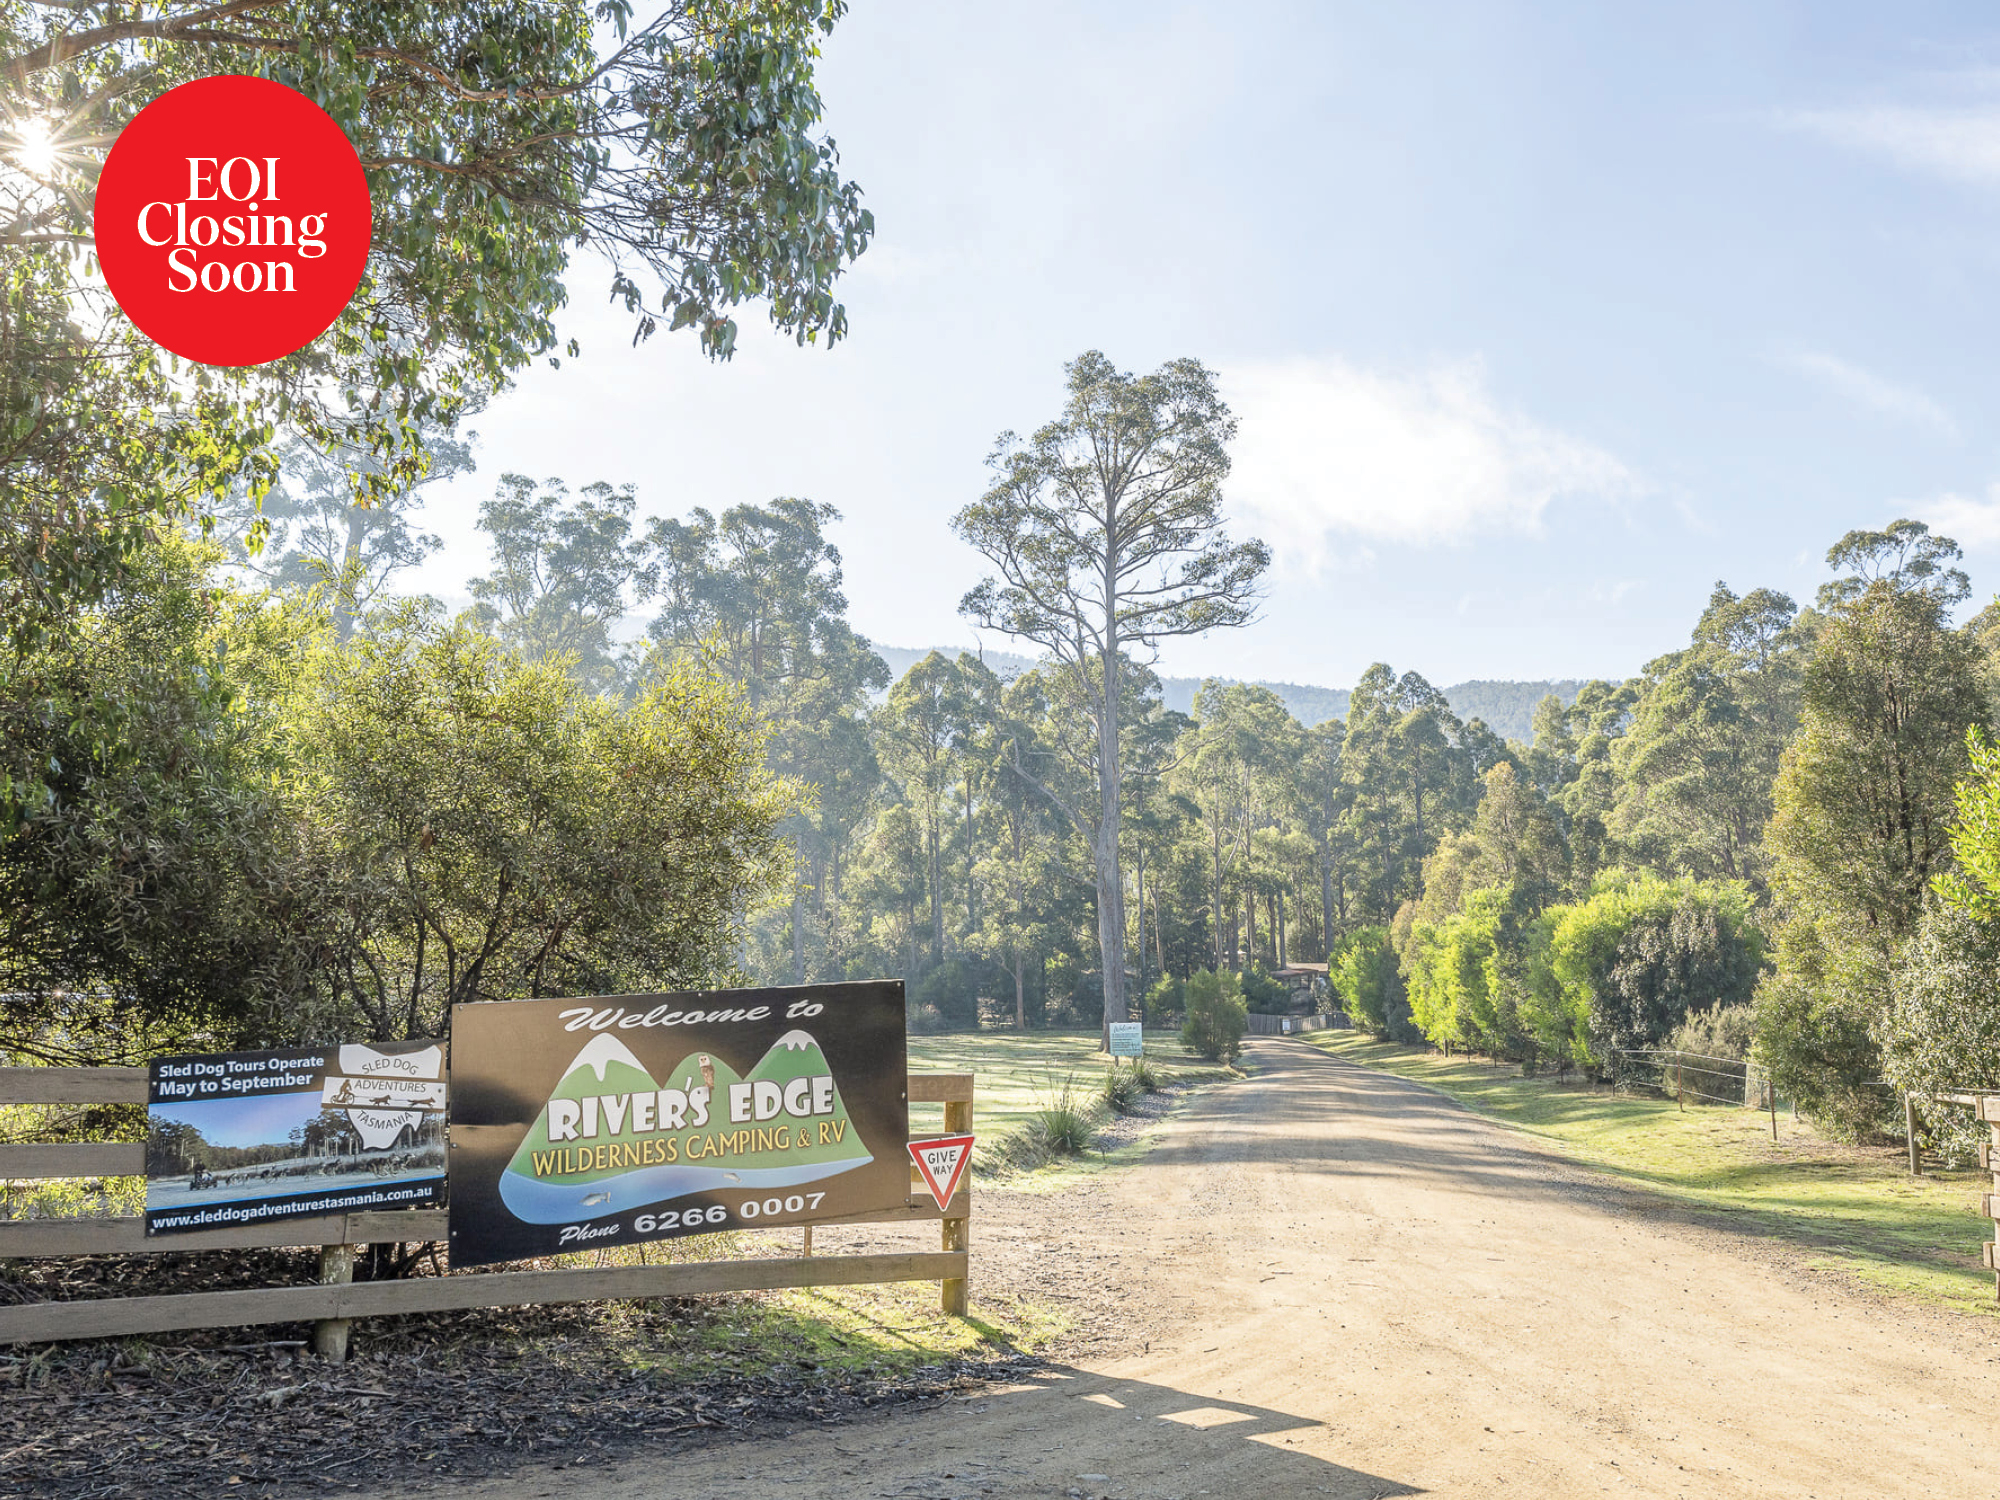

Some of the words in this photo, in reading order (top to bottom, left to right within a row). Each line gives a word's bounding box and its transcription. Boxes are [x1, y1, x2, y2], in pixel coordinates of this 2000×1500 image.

[558, 1004, 771, 1032] Welcome
[785, 999, 824, 1018] to
[159, 1064, 192, 1078] Sled
[194, 1063, 225, 1077] Dog
[227, 1060, 265, 1073] Tours
[268, 1056, 324, 1071] Operate
[362, 1059, 390, 1074] SLED
[393, 1058, 418, 1075] DOG
[159, 1080, 197, 1096] May
[200, 1078, 218, 1093] to
[221, 1072, 313, 1092] September
[354, 1079, 426, 1092] ADVENTURES
[356, 1109, 413, 1130] TASMANIA
[547, 1076, 710, 1142] RIVER'S
[729, 1075, 834, 1123] EDGE
[532, 1137, 678, 1177] WILDERNESS
[686, 1127, 791, 1159] CAMPING
[797, 1128, 811, 1147] &
[819, 1119, 846, 1144] RV
[927, 1150, 958, 1165] GIVE
[933, 1164, 954, 1176] WAY
[152, 1186, 432, 1229] www.sleddogadventurestasmania.com.au
[559, 1222, 620, 1246] Phone
[634, 1205, 727, 1233] 6266
[740, 1192, 825, 1219] 0007
